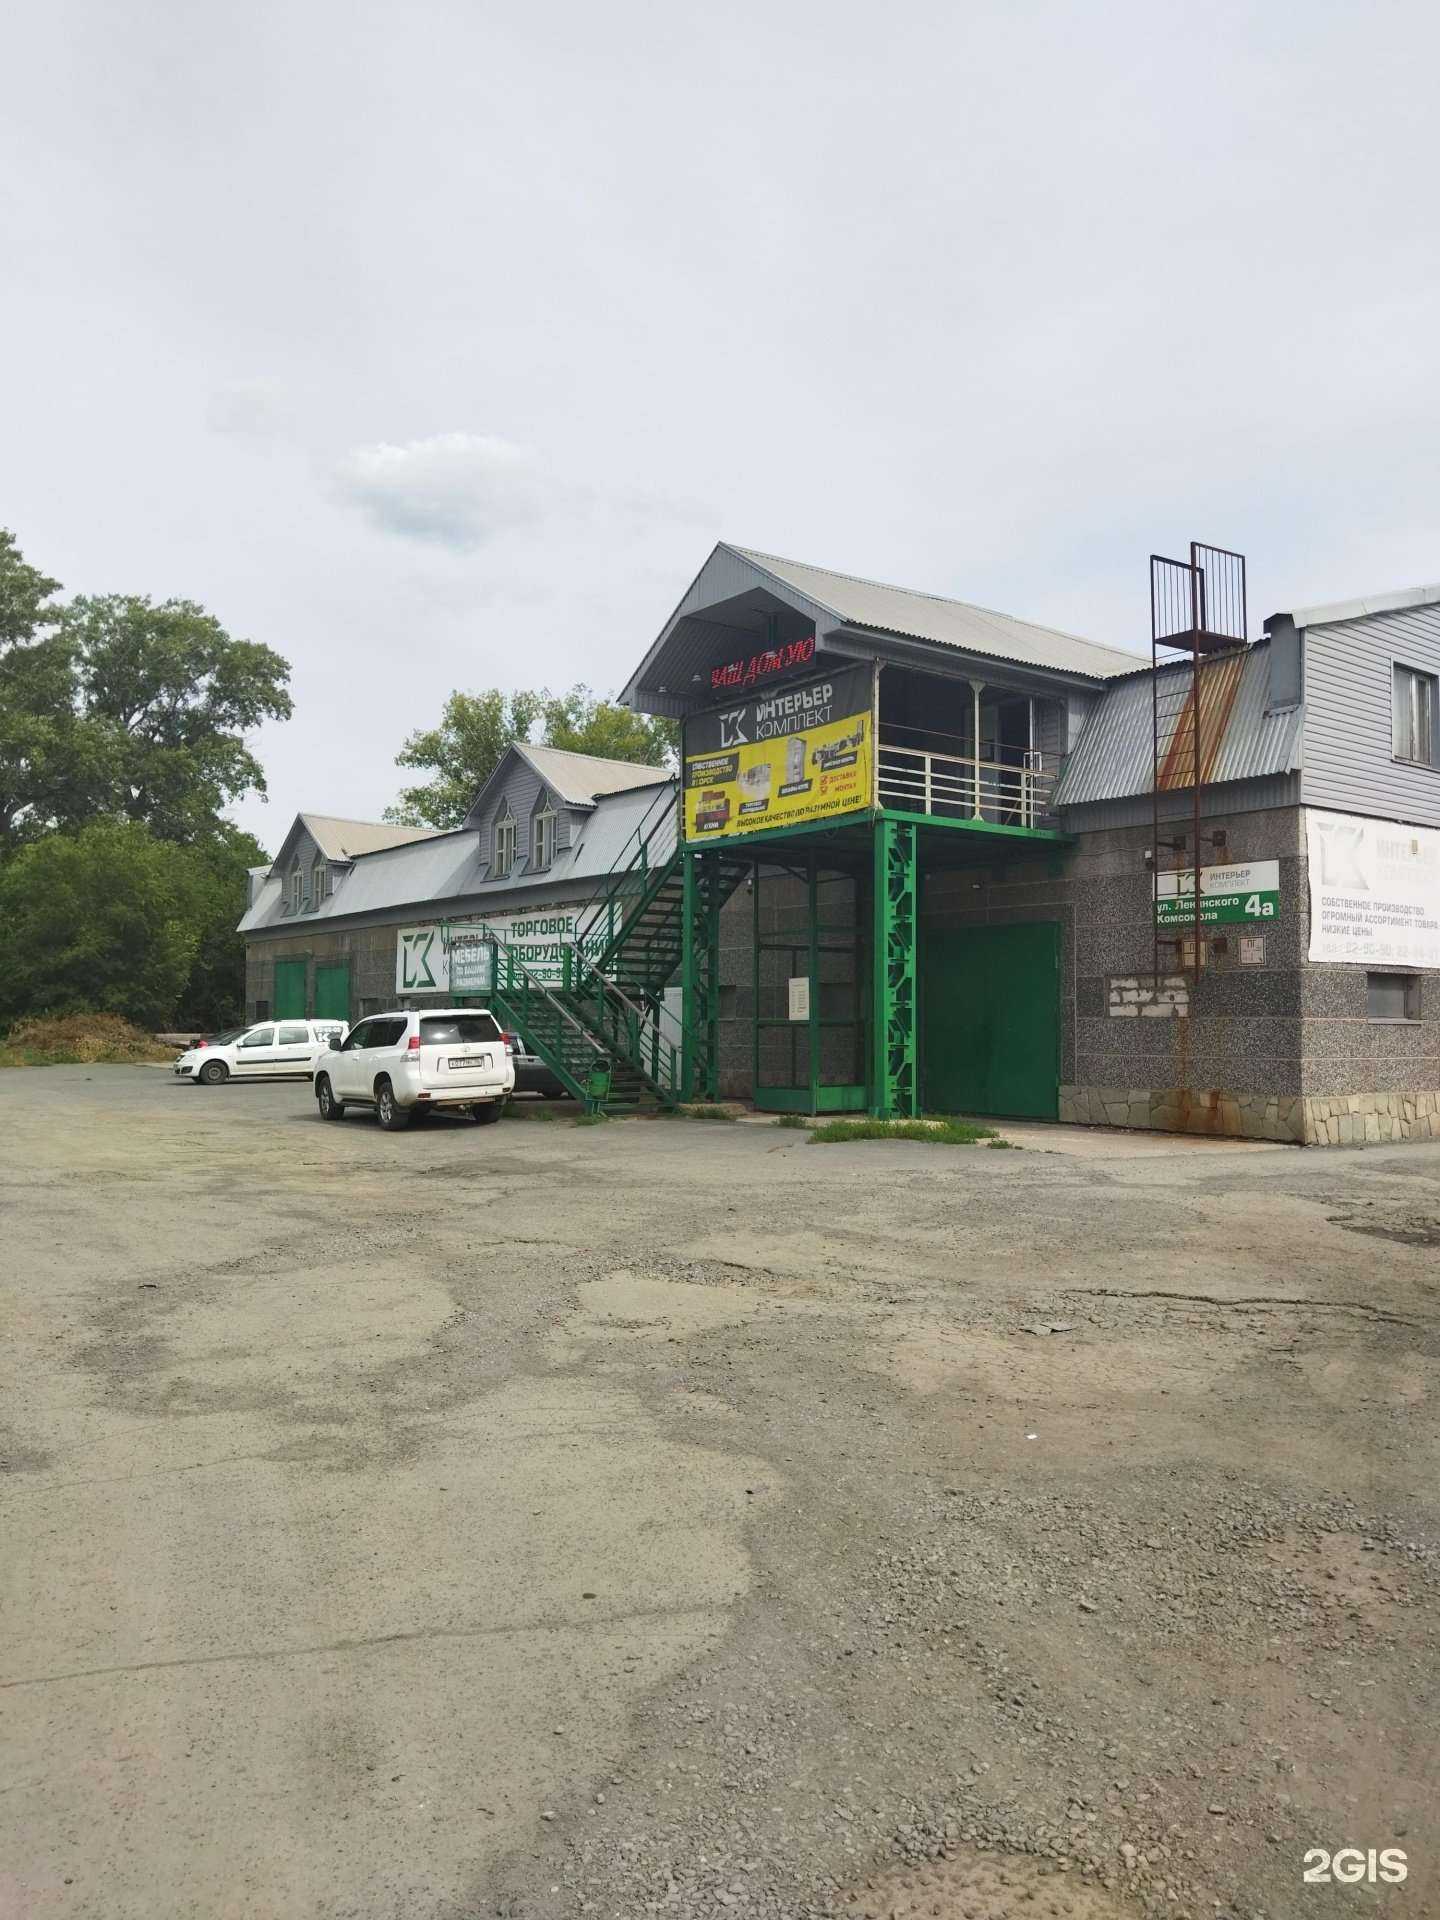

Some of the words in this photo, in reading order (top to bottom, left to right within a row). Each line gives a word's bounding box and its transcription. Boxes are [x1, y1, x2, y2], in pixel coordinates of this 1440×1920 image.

[756, 684, 833, 722] ИНТЕРЬЕР
[756, 705, 832, 740] КОМПЛЕКТ
[1209, 870, 1251, 880] ИНТЕРЬЕР
[1157, 902, 1172, 914] ул.
[1244, 894, 1274, 917] 4а
[1321, 897, 1372, 911] СОБСТВЕННОЕ
[1373, 902, 1425, 916] ПРОИЗВОДСТВО
[511, 916, 573, 938] ТОРГОВОЕ
[1321, 911, 1363, 923] ОГРОМНЫЙ
[1364, 914, 1412, 927] АССОРТИМЕНТ
[1321, 924, 1351, 935] НИЗКИЕ
[452, 947, 490, 964] МЕБЕЛЬ
